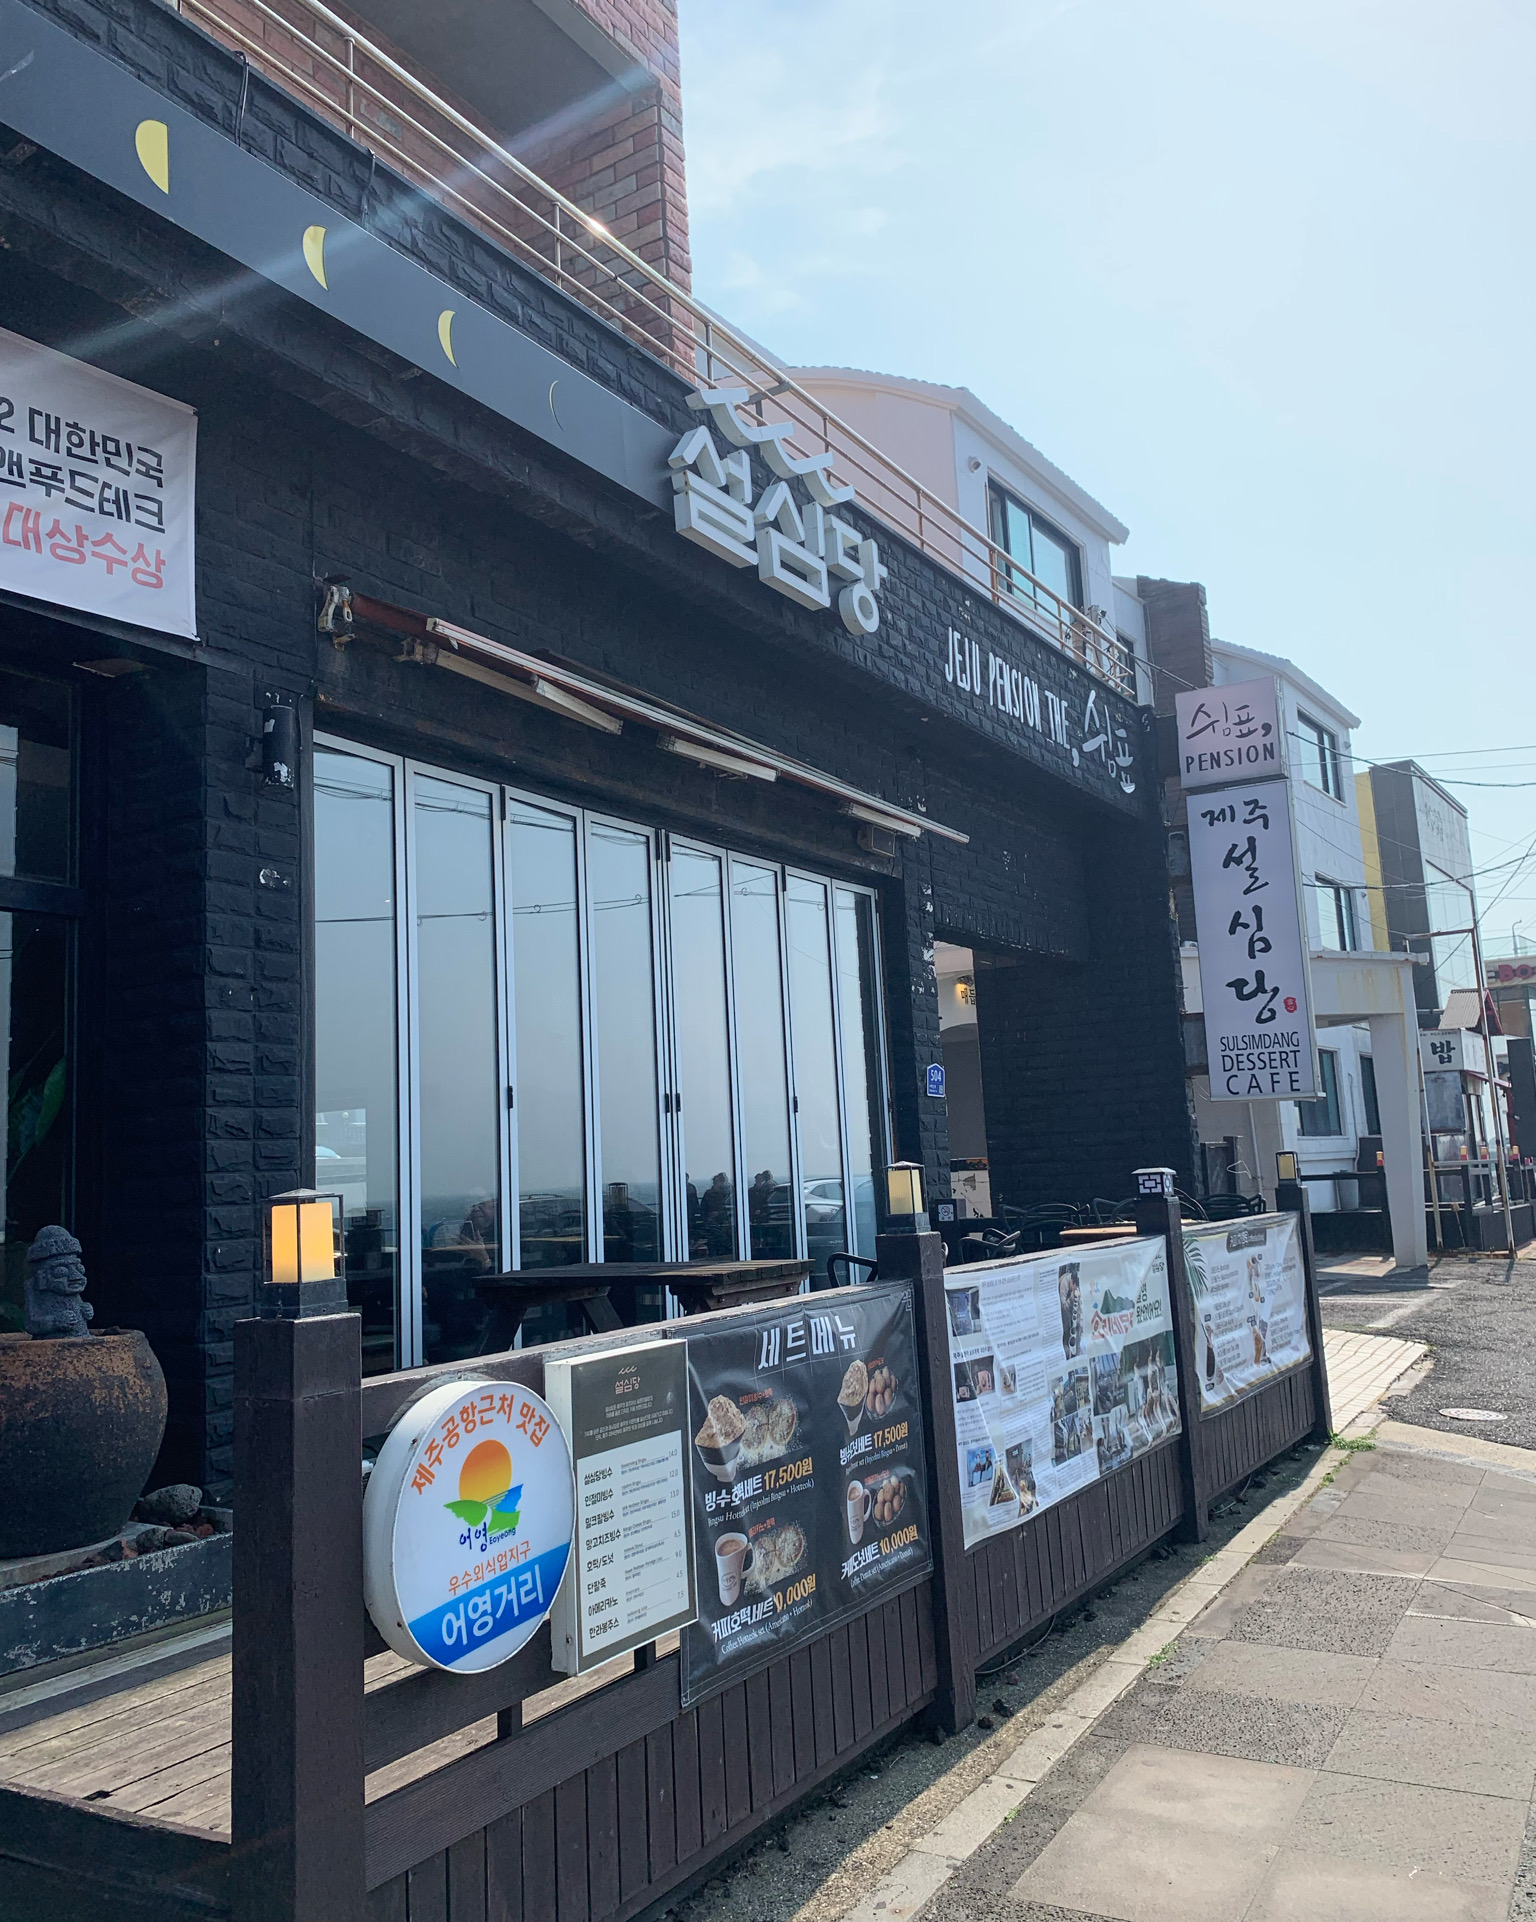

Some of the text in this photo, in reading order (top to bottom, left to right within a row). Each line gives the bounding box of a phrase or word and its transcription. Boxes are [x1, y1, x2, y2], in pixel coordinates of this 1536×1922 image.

[28, 406, 164, 488] 대한민국
[2, 501, 167, 589] 대상수상
[667, 425, 889, 635] 설심당
[944, 626, 981, 695] JEJU
[988, 651, 1042, 733] PENSION
[1044, 689, 1071, 750] THE
[1185, 742, 1275, 774] PENSION
[1200, 798, 1270, 830] 제주
[1220, 1031, 1300, 1053] SULSIMDANG
[1429, 1039, 1456, 1065] 밥
[930, 1069, 942, 1082] 504
[1221, 1048, 1301, 1073] DESSERT
[1225, 1070, 1301, 1097] CAFE
[758, 1314, 857, 1370] 세트메뉴
[614, 1376, 641, 1395] 설심당
[411, 1393, 514, 1495] 제주공항근처
[516, 1402, 551, 1448] 맛집
[873, 1421, 909, 1449] 17,500원
[584, 1466, 613, 1486] 설심당빙수
[764, 1457, 814, 1491] 17,500원
[584, 1488, 614, 1507] 인절미빙수
[459, 1522, 488, 1552] 어영
[879, 1524, 919, 1556] 10,000원
[449, 1540, 532, 1596] 우수외식업지구
[441, 1564, 544, 1648] 어영거리
[588, 1597, 619, 1617] 아메리카노
